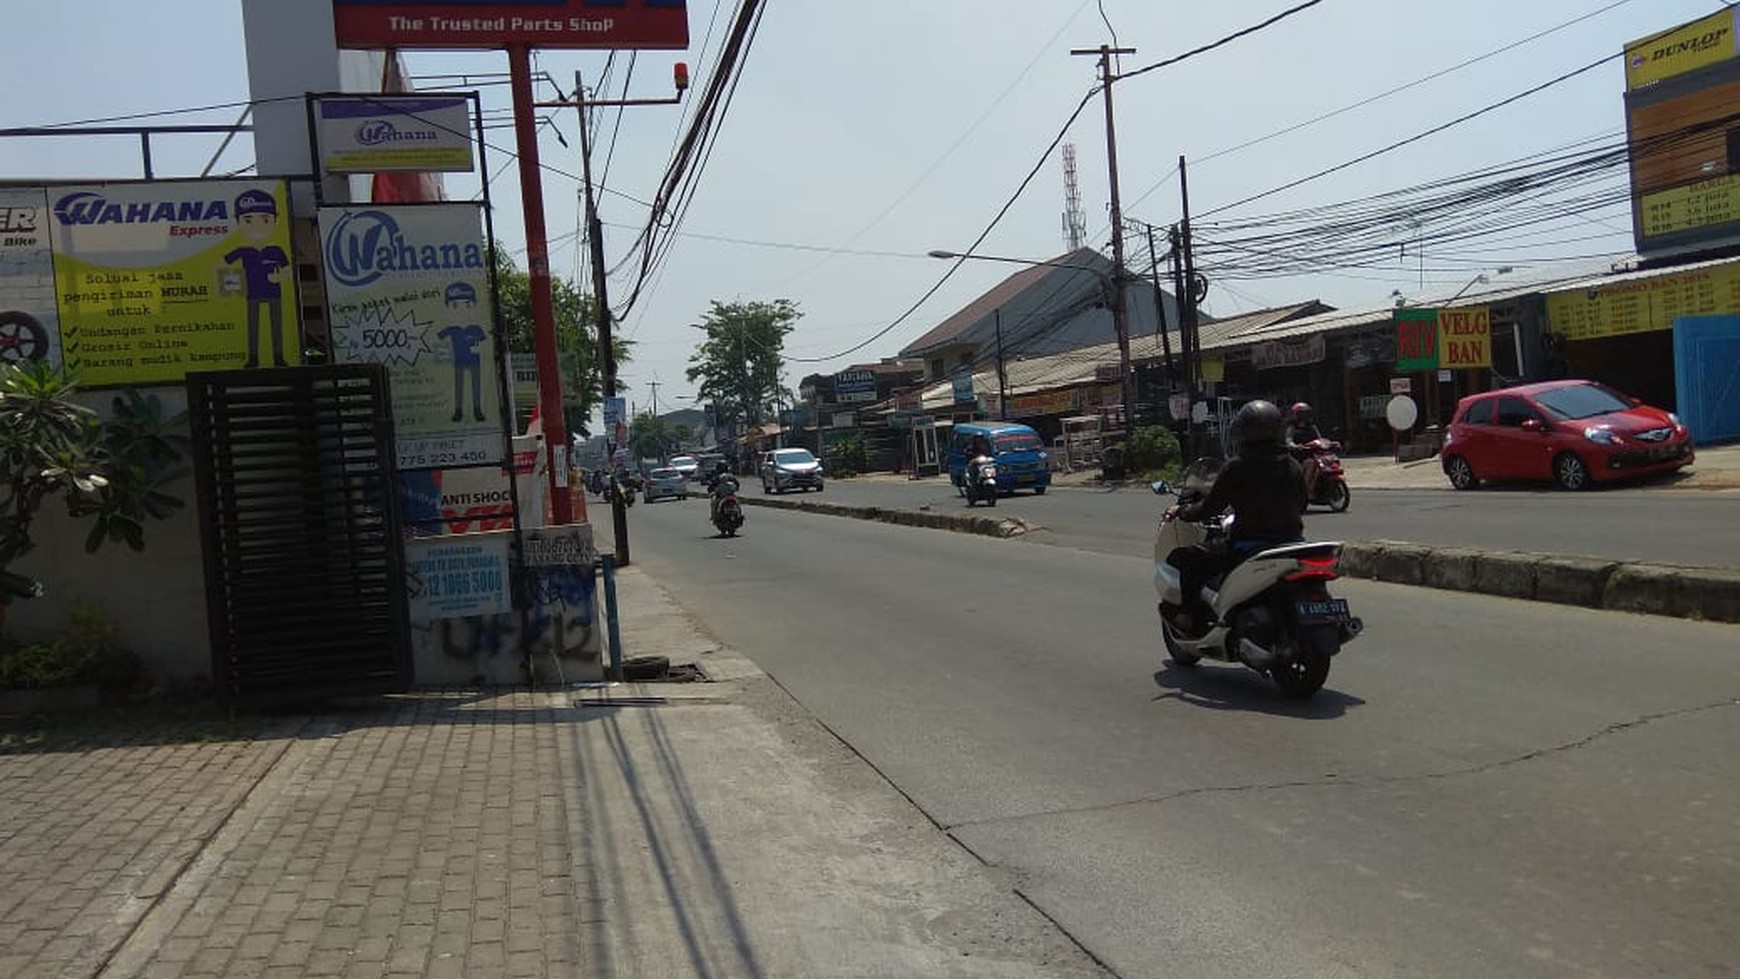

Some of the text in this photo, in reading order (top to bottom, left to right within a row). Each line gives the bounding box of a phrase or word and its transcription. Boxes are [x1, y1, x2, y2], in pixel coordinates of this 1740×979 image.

[389, 16, 423, 31] The
[429, 17, 505, 31] Trusted
[511, 17, 563, 31] Parts
[1651, 28, 1728, 61] DUNLOP
[54, 191, 229, 225] WAHANA
[169, 224, 229, 239] Express
[327, 209, 483, 288] Wahana
[63, 285, 209, 305] pengiriman MURAH
[106, 303, 151, 317] untuk
[1447, 341, 1483, 363] BAN
[472, 491, 510, 503] SHOC
